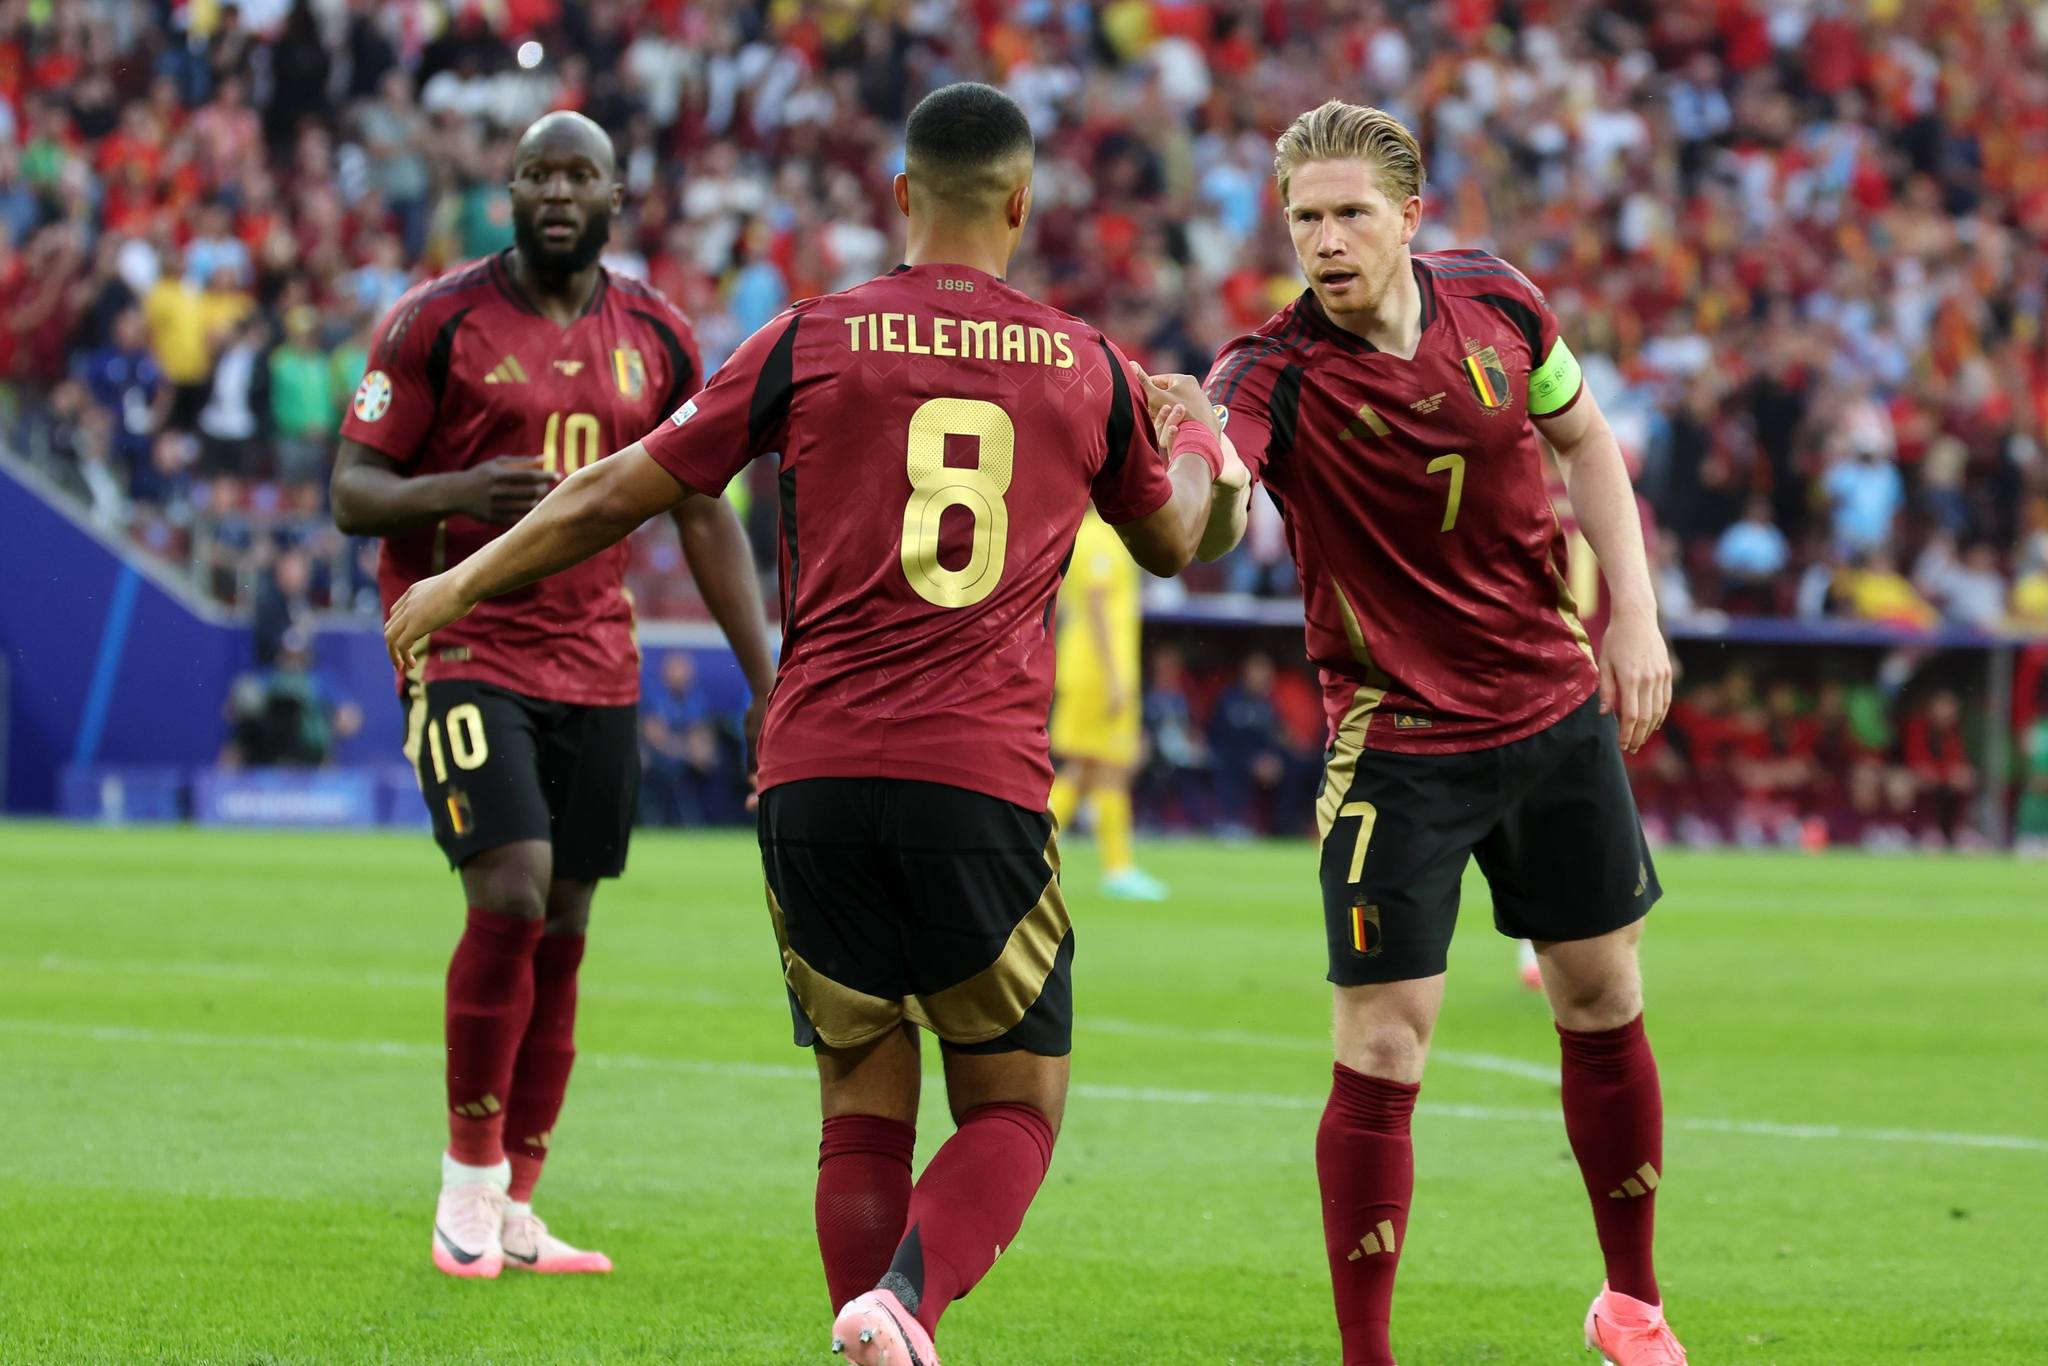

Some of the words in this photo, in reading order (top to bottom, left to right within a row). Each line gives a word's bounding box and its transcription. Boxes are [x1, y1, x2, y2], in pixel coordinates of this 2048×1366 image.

[936, 279, 974, 293] 1895
[844, 312, 1074, 368] TIELEMANS
[543, 411, 599, 476] 10
[901, 397, 1015, 608] 8
[1426, 453, 1466, 533] 7
[428, 703, 489, 785] 10
[1339, 801, 1377, 884] 7
